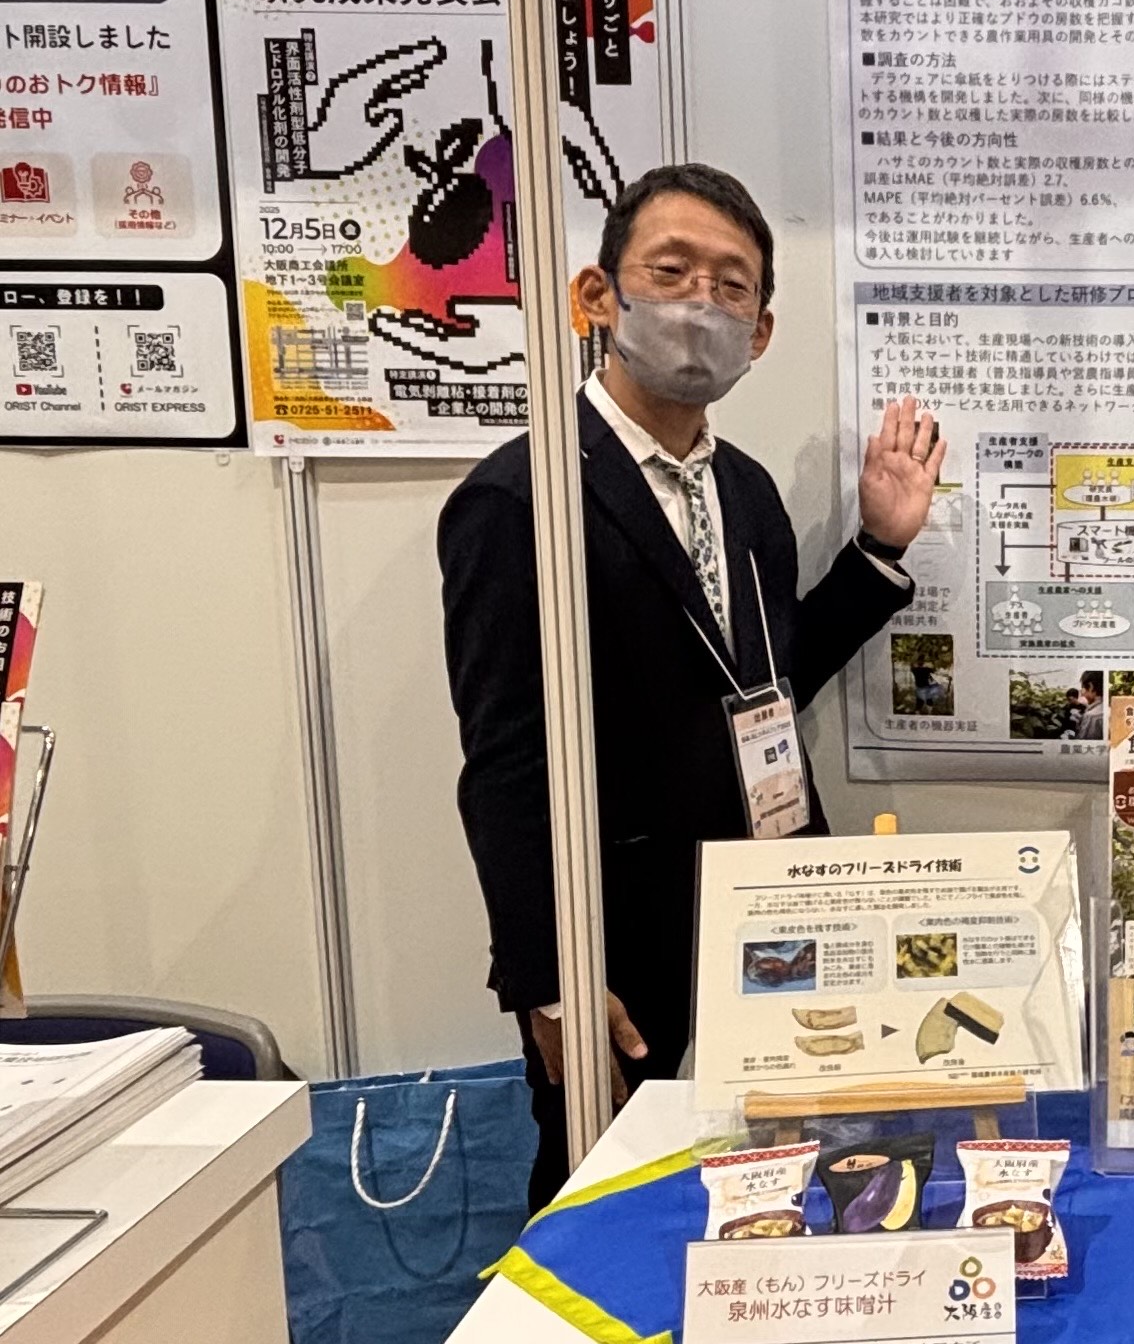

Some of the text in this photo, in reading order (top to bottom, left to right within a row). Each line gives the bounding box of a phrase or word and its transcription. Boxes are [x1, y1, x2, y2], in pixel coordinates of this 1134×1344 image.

[5, 24, 171, 50] ト開設しました
[877, 52, 956, 68] 調査の方法
[0, 73, 159, 96] のおトク情報』
[269, 41, 291, 178] ヒドロゲル化剤の開発
[286, 41, 308, 174] 界面活性剤型低分子
[876, 131, 1018, 148] 結果と今後の方向性
[128, 209, 161, 220] その他
[865, 211, 1034, 226] であることがわかりました。
[260, 217, 336, 240] 12月5日
[261, 243, 362, 254] 10:00 17:00
[865, 248, 1013, 262] 導入も検討していきます
[264, 259, 348, 271] 大阪商工会議所
[881, 311, 958, 328] 背景と目的
[34, 384, 67, 395] YouTube
[40, 401, 81, 411] Channel
[115, 402, 206, 412] ORIST EXPRESS
[989, 436, 1038, 447] 生産者支援
[984, 448, 1044, 458] ネットワークの
[1004, 460, 1023, 470] 構築
[885, 719, 978, 732] 生産者の機器実証
[787, 859, 962, 878] 水なすのフリーズドライ技術
[698, 1270, 925, 1298] 大阪産（もん）フリーズドライ
[728, 1293, 897, 1322] 泉州水なす味噌汁
